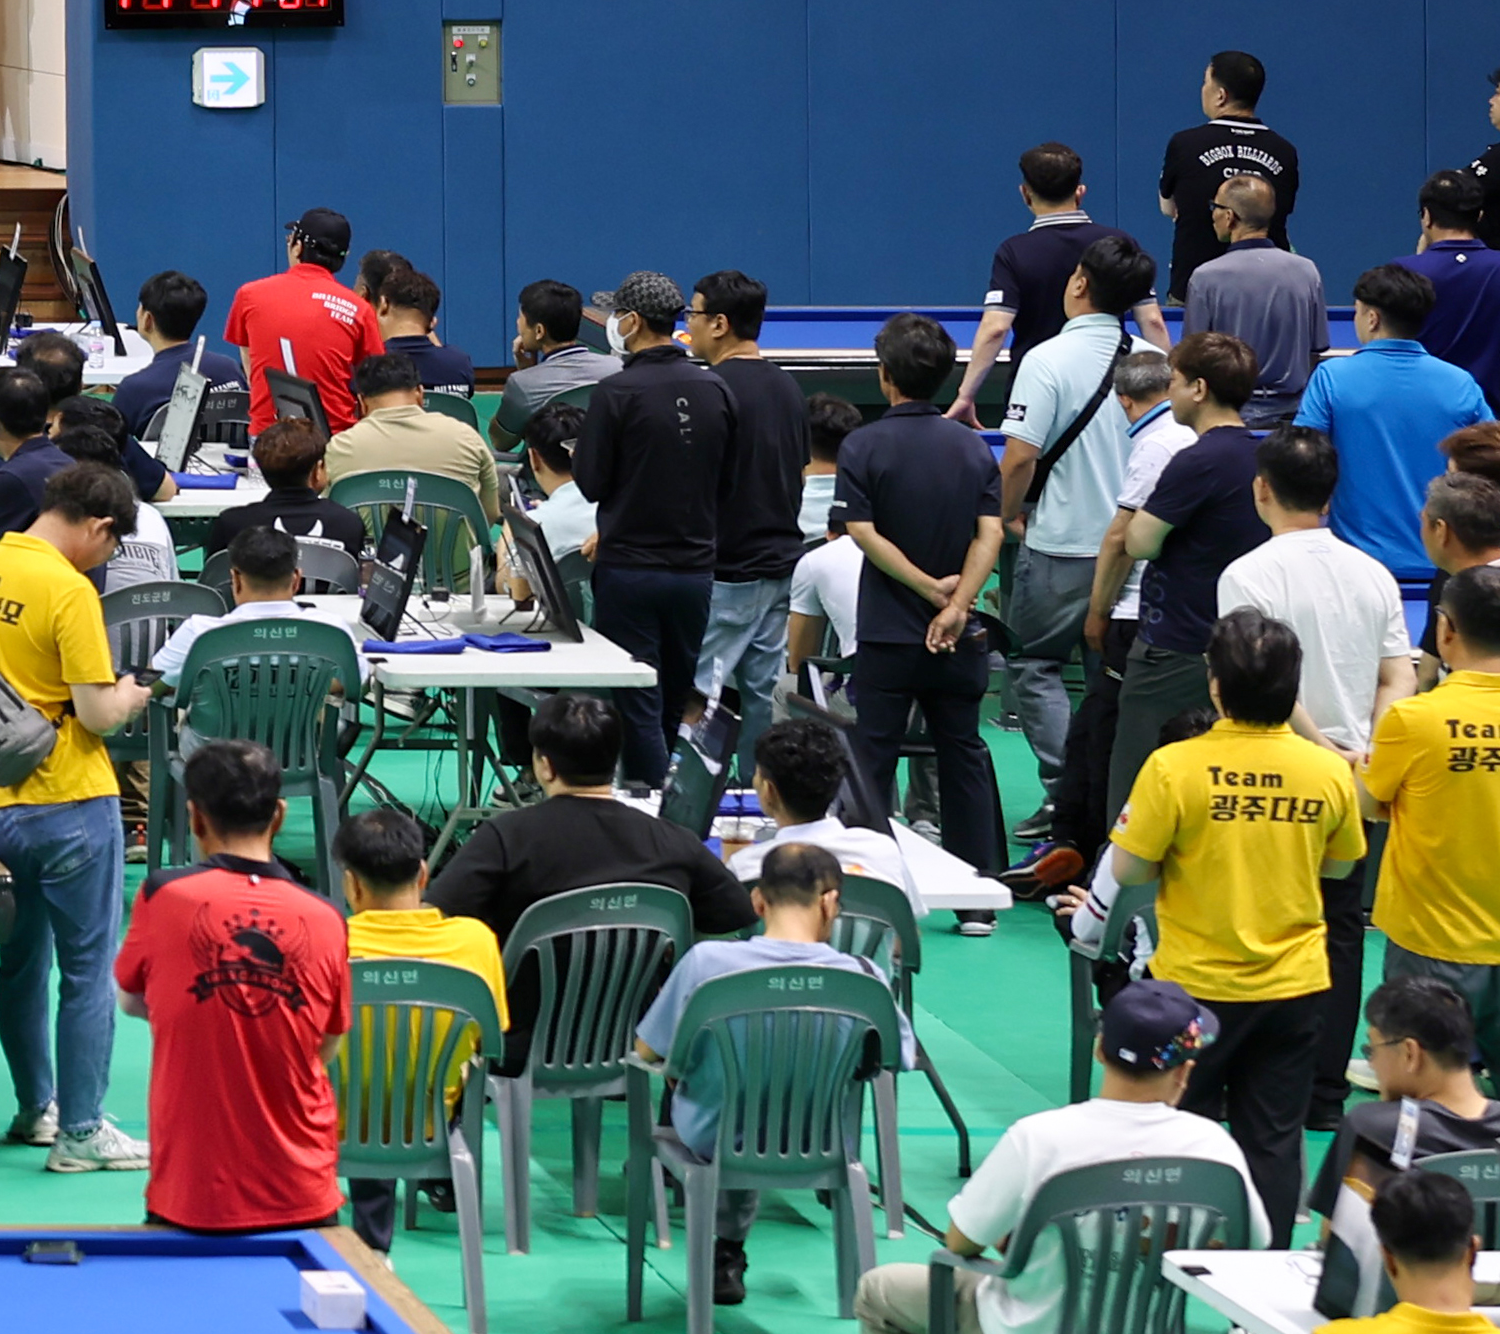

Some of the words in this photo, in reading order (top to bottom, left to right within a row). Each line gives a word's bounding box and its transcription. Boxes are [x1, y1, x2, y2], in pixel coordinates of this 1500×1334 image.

[1198, 145, 1235, 167] BIGBOX
[1236, 145, 1284, 176] BILLIARDS
[311, 291, 358, 312] BILLIARDS
[331, 311, 354, 326] TEAM
[1445, 719, 1500, 739] Tea
[1447, 746, 1500, 773] 광주
[1207, 766, 1284, 789] Team
[1209, 794, 1325, 824] 광주다모
[1459, 1164, 1500, 1180] 의신
